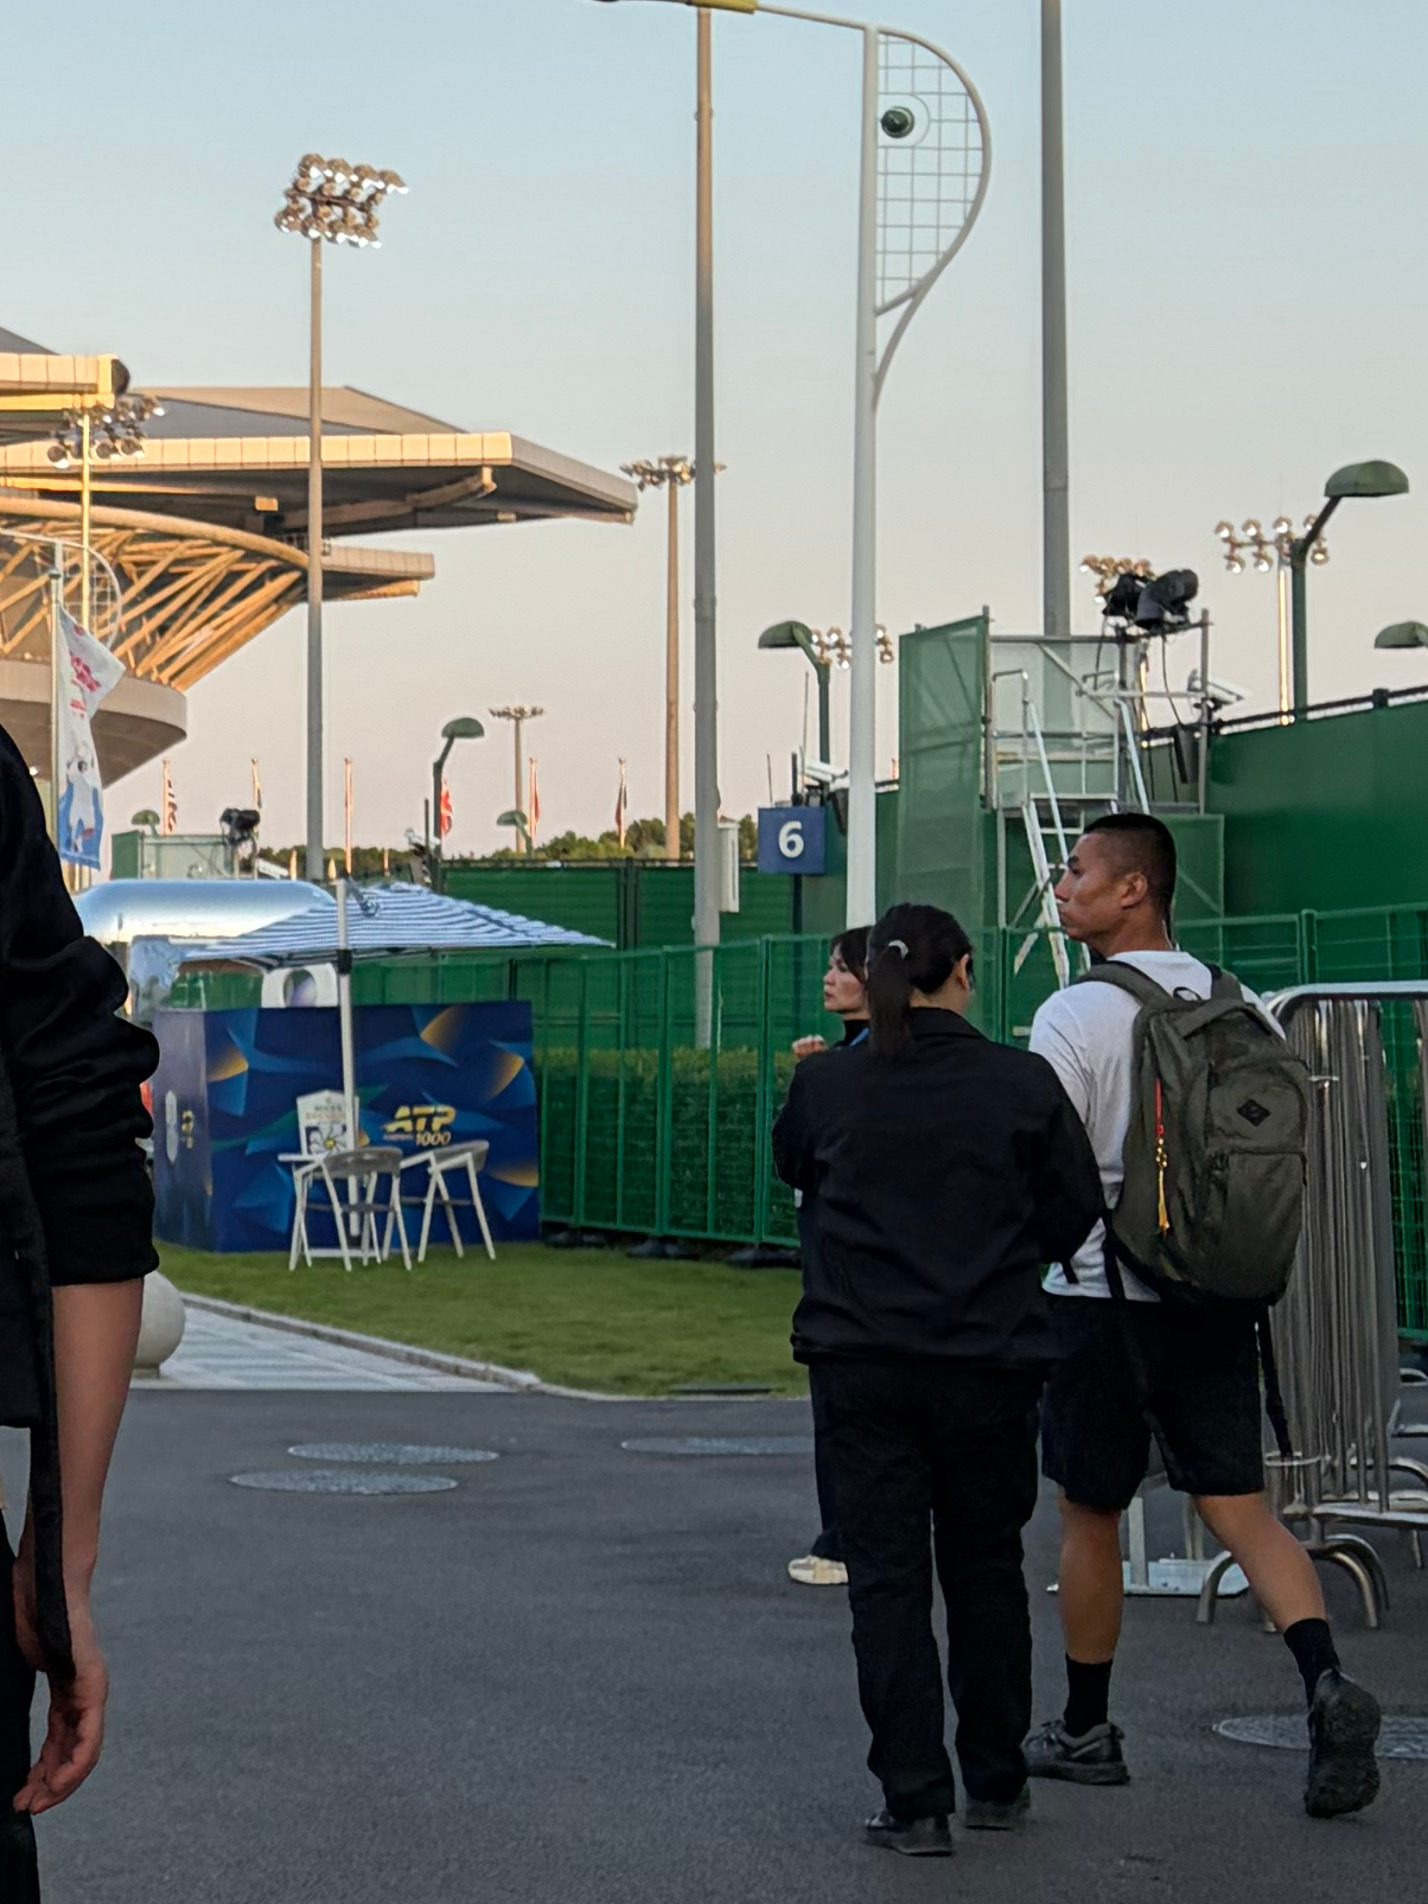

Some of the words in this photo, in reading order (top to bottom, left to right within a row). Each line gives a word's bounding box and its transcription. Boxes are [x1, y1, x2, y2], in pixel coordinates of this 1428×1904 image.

[779, 821, 804, 858] 6
[383, 1105, 456, 1132] ATP
[415, 1131, 451, 1146] 1000
